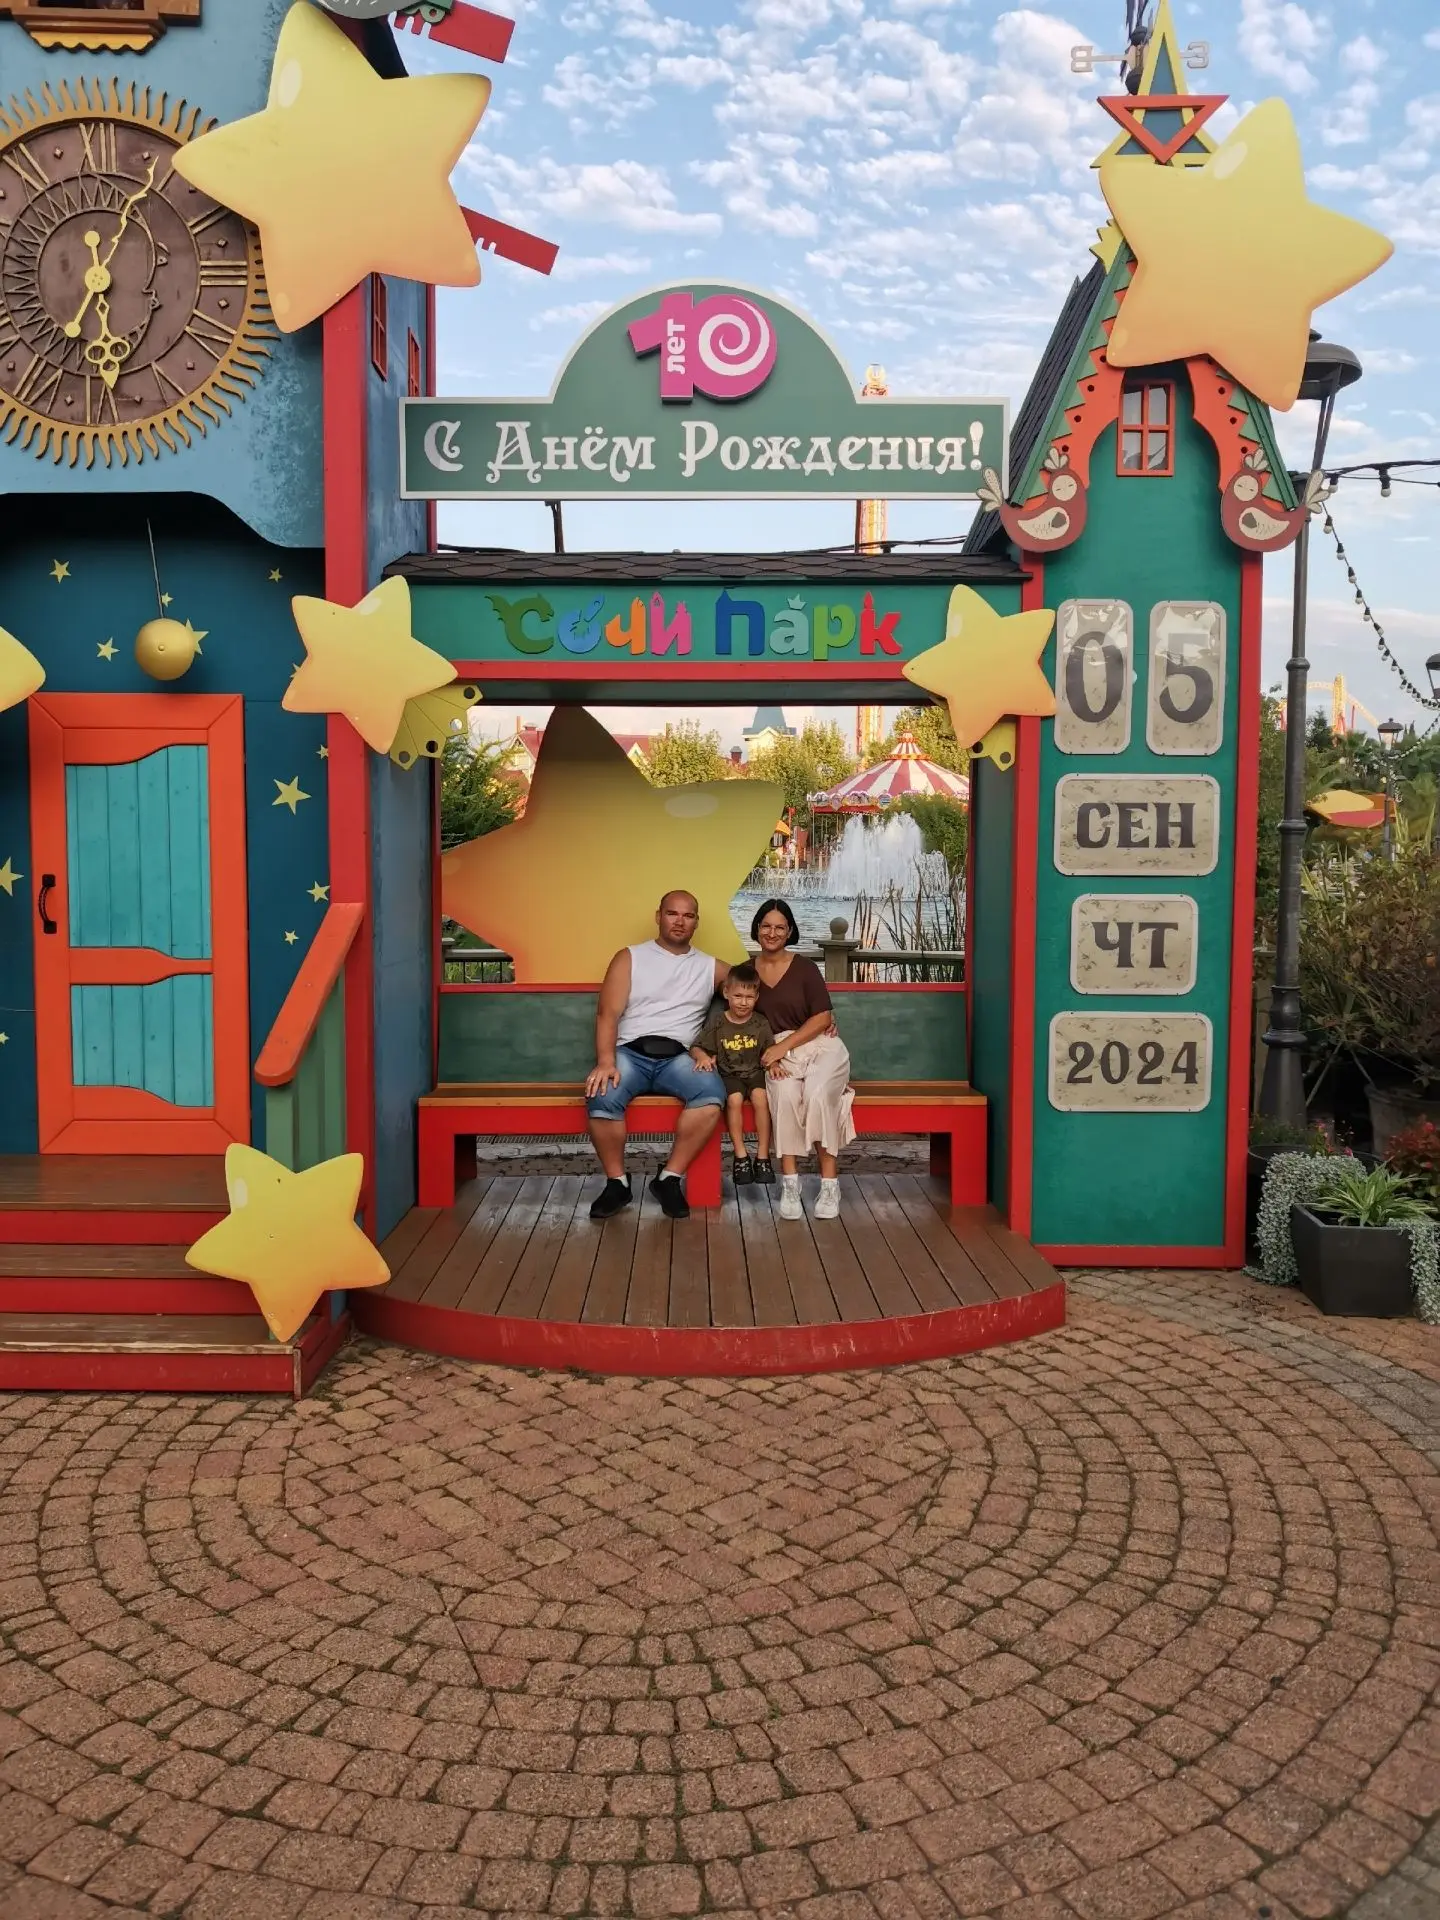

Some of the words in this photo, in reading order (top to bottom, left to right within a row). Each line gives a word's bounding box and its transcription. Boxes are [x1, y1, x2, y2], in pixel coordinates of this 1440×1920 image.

[79, 121, 118, 174] XII
[200, 260, 248, 287] III
[627, 292, 778, 401] 10
[667, 318, 686, 374] лет
[424, 421, 464, 472] С
[485, 420, 656, 483] Днём
[679, 420, 985, 476] Рождения!
[1075, 801, 1197, 850] СЕН
[1091, 921, 1179, 969] ЧТ
[1066, 1040, 1199, 1086] 2024
